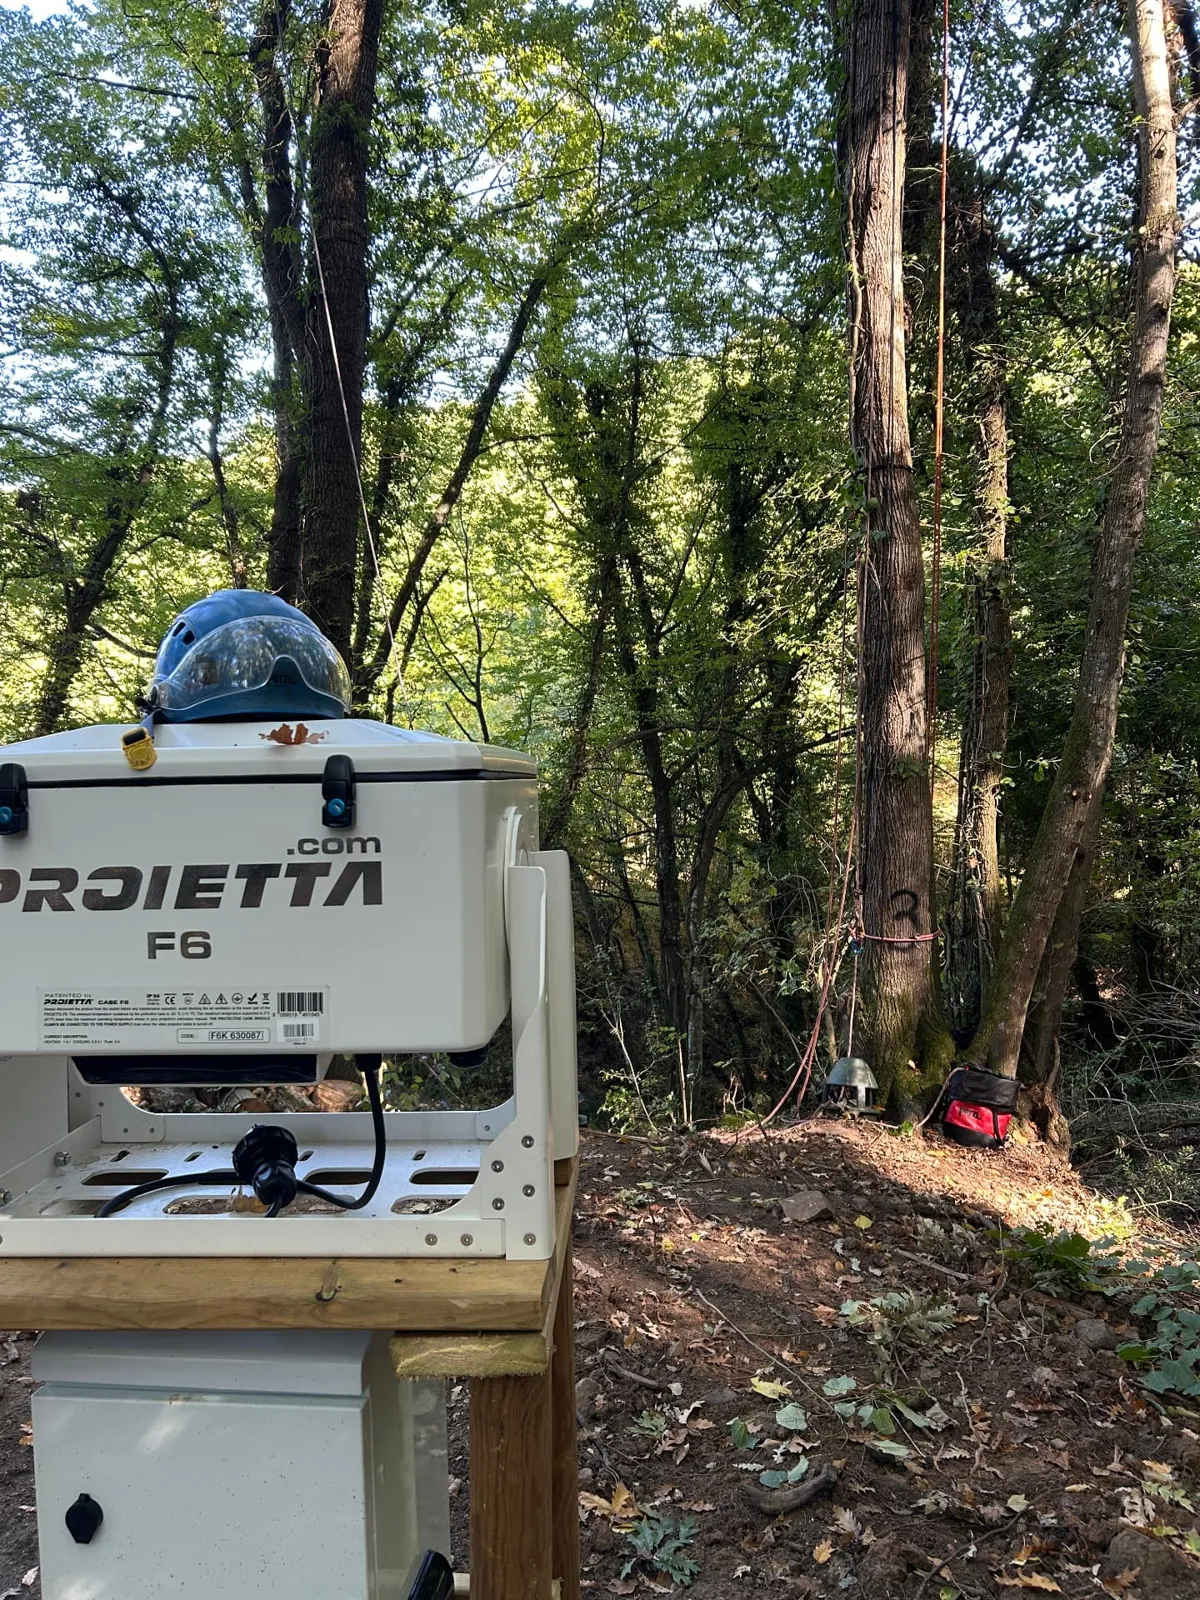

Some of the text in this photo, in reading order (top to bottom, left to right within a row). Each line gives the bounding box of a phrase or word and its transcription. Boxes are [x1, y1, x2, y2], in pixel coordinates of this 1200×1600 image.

[287, 836, 381, 855] .com
[147, 931, 212, 960] F6
[210, 1031, 261, 1040] F6K 630087
